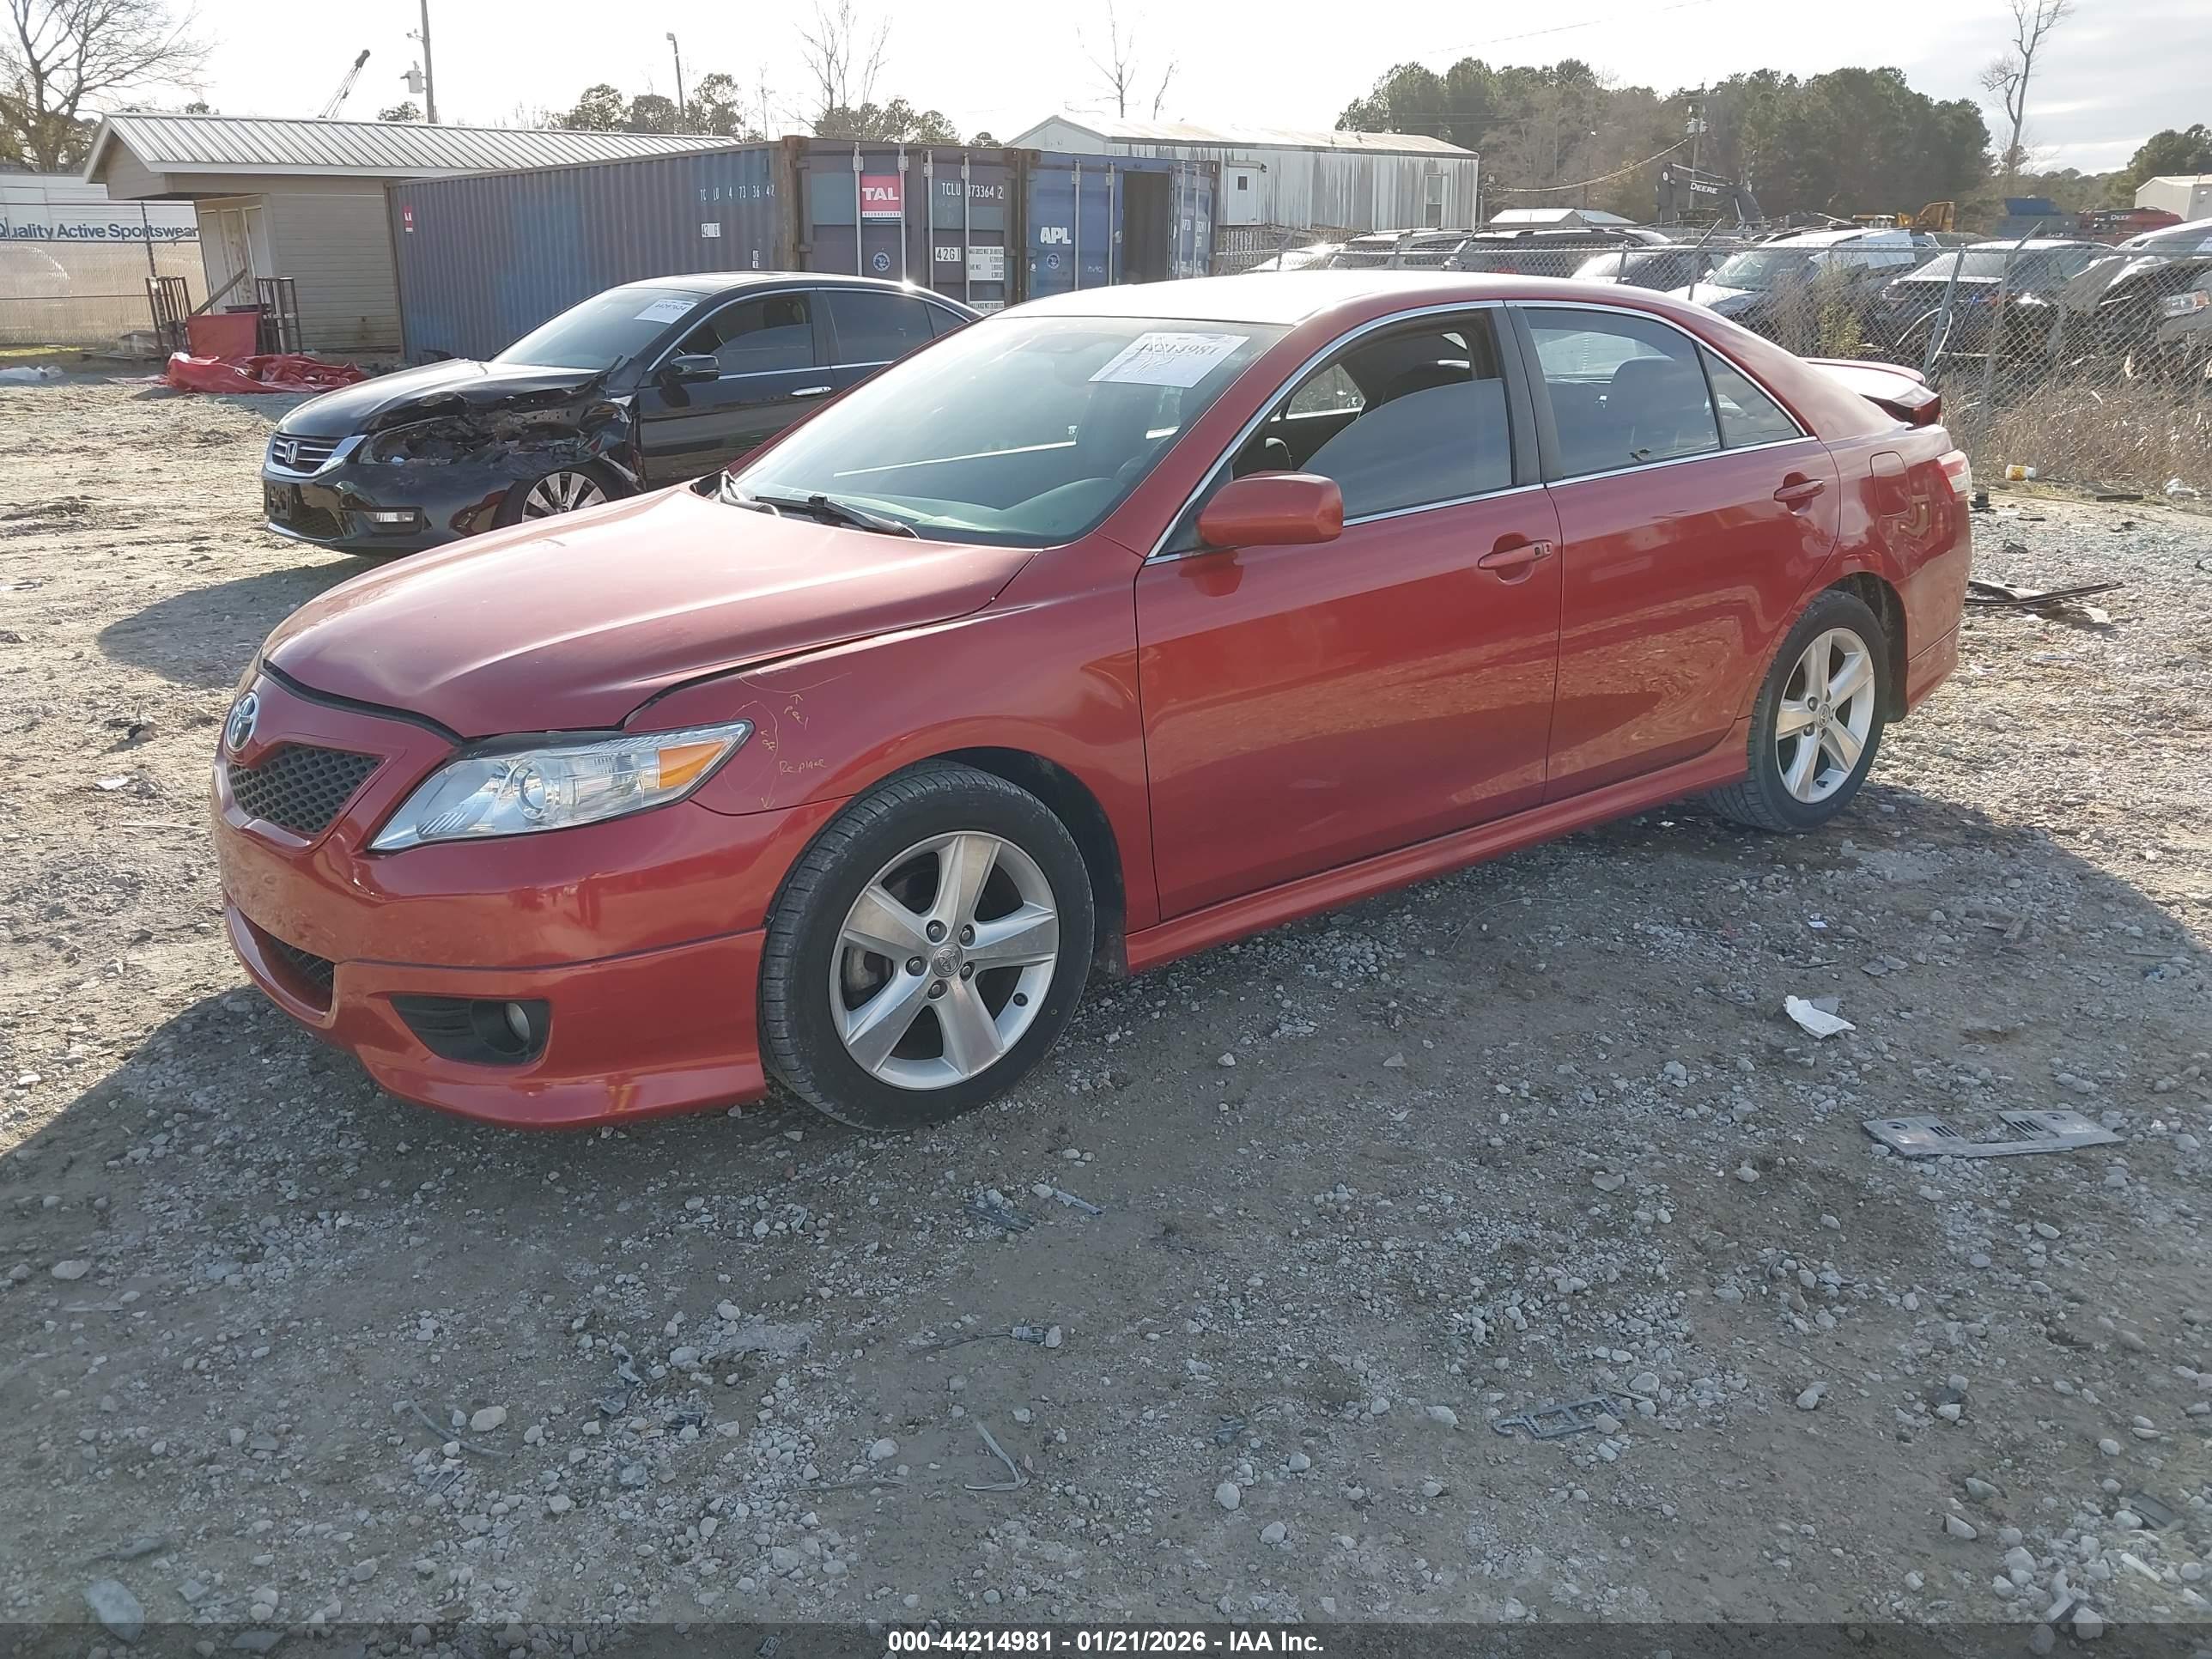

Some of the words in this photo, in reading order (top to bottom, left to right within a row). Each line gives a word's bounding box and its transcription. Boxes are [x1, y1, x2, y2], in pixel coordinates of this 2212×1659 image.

[861, 187, 900, 202] TAL
[941, 182, 961, 197] TCLU
[1690, 182, 1717, 194] DEERE
[57, 222, 106, 239] Active
[107, 222, 198, 240] Sportswear
[1040, 227, 1072, 245] APL
[936, 247, 960, 260] 42G1
